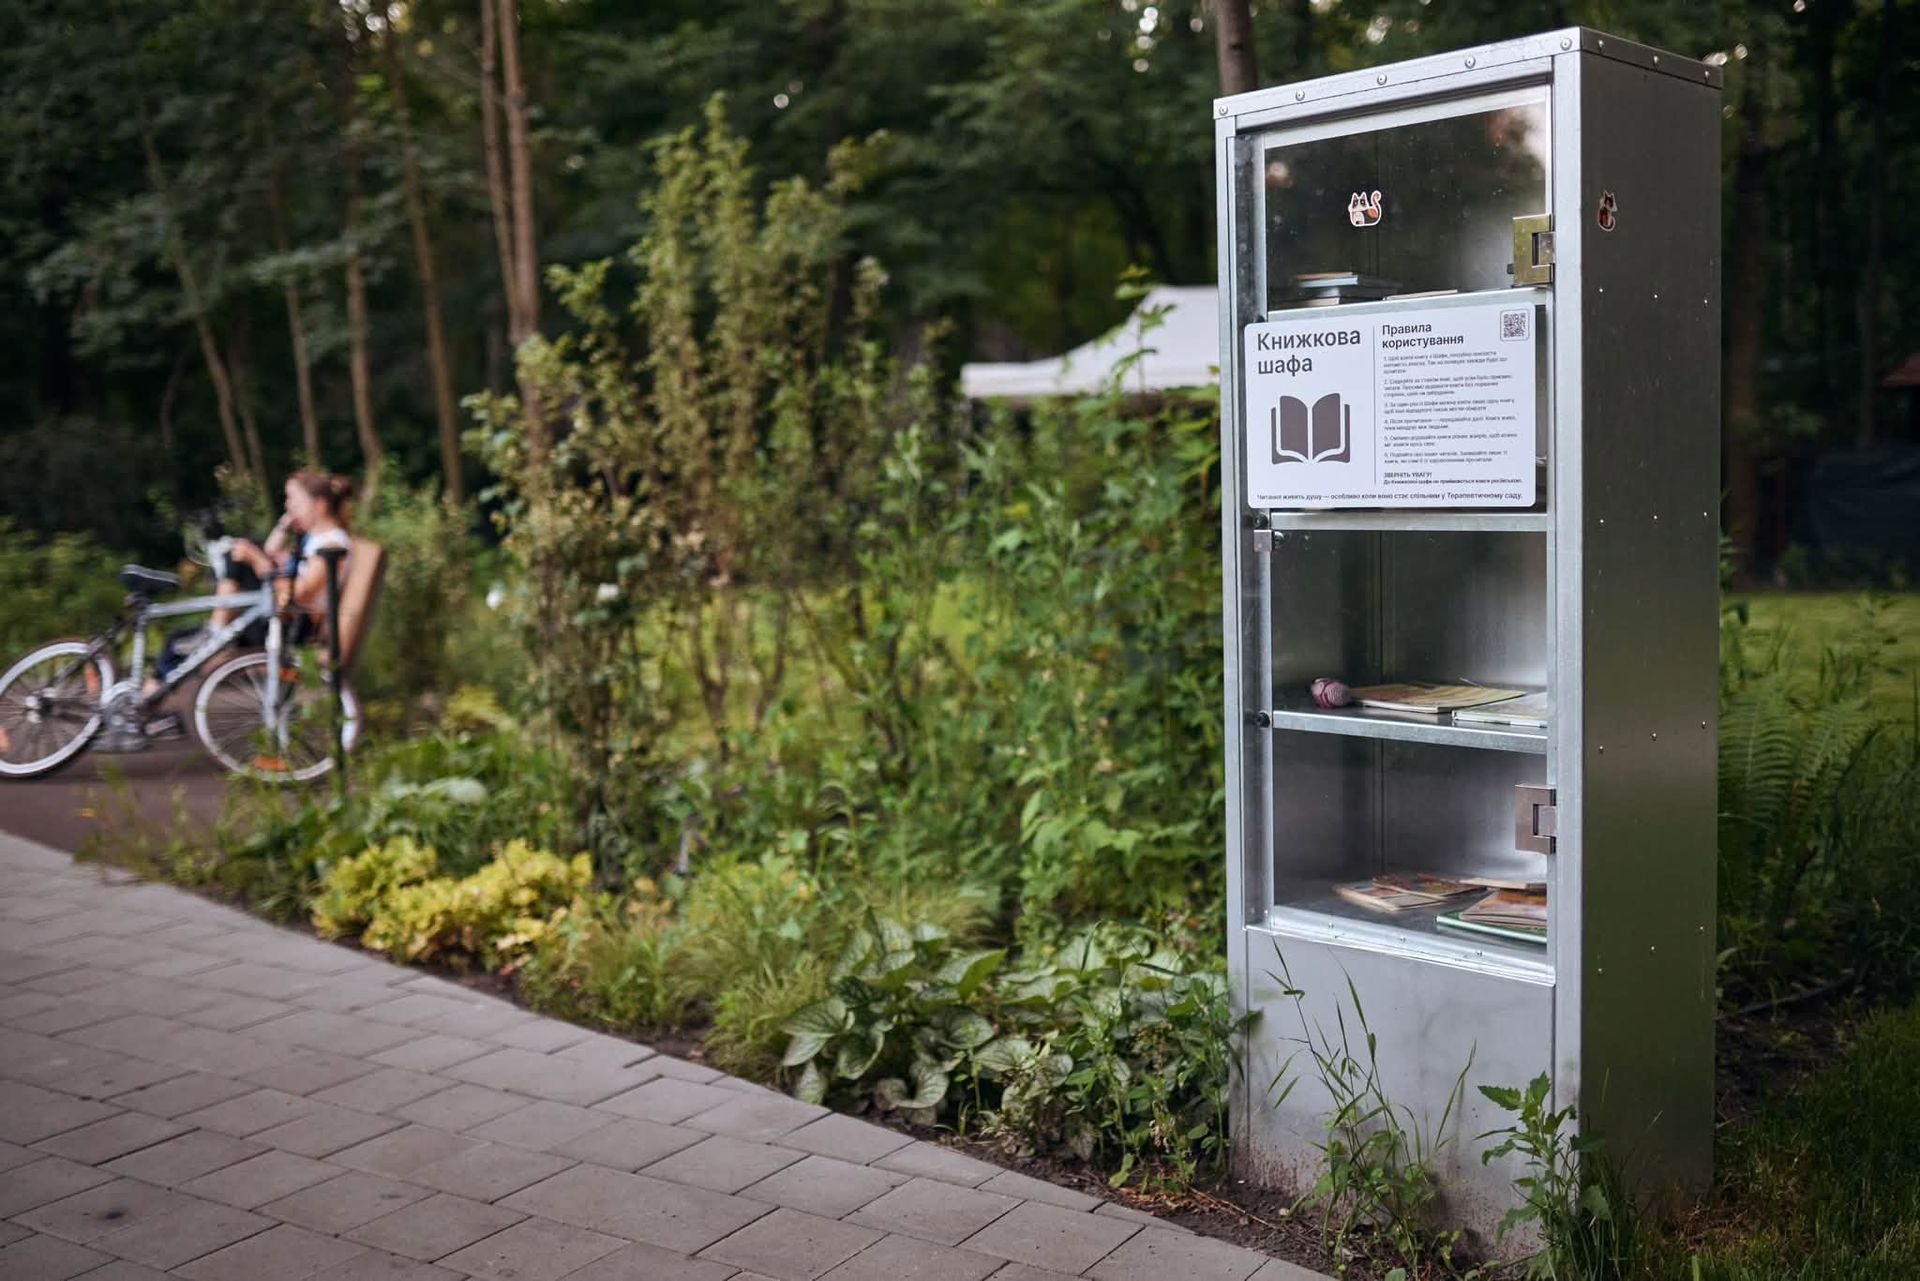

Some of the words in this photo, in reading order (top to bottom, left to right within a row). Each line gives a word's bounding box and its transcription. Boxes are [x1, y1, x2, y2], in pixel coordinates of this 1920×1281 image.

[1382, 323, 1432, 337] Правила
[1258, 329, 1361, 351] Книжкова
[1382, 335, 1464, 350] користування
[1258, 355, 1313, 377] шафа
[1306, 494, 1322, 502] душу
[1410, 492, 1440, 500] спільним
[1441, 493, 1446, 501] у
[1447, 492, 1503, 501] Терапевтичному
